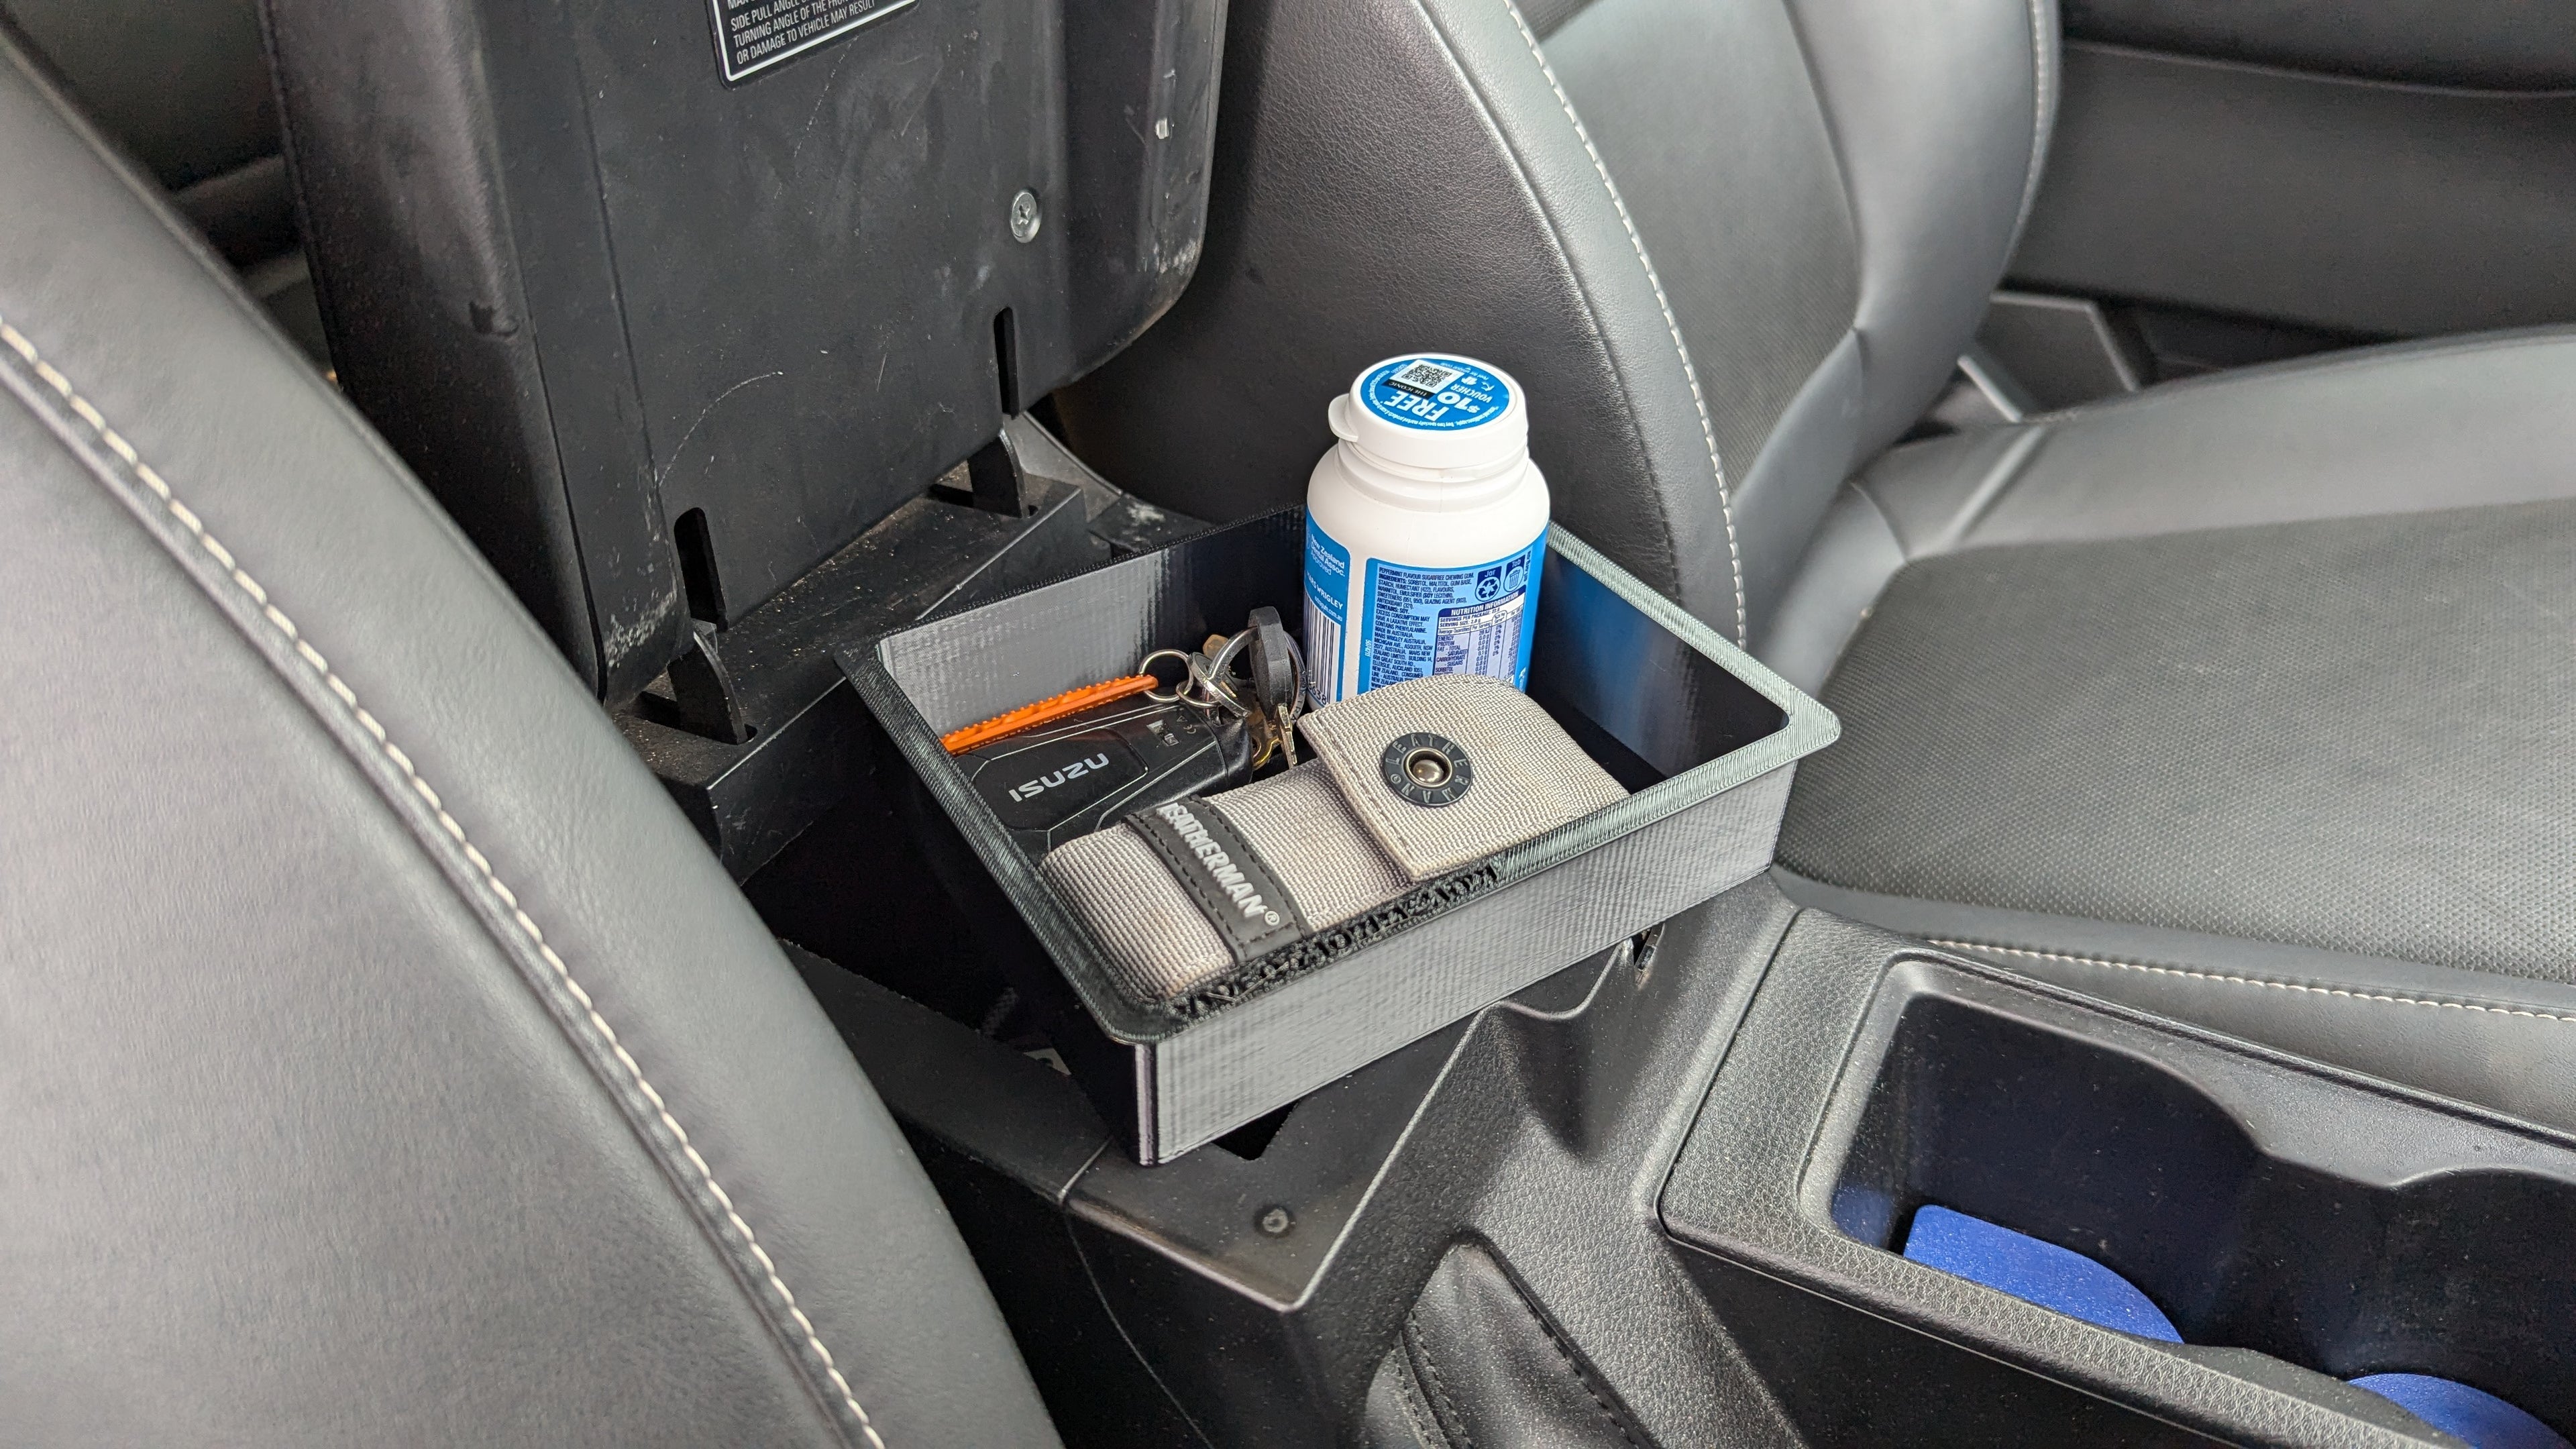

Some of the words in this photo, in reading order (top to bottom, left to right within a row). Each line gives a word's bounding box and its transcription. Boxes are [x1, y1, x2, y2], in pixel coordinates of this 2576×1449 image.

[731, 12, 751, 32] SIDE
[751, 5, 772, 23] PULL
[733, 22, 772, 48] TURNING
[773, 10, 799, 32] ANGLE
[800, 5, 810, 20] OF
[812, 0, 827, 15] THE
[737, 49, 749, 65] OR
[750, 33, 786, 59] DAMAGE
[786, 28, 797, 43] TO
[798, 15, 829, 38] VEHICLE
[830, 7, 847, 25] MAY
[1389, 381, 1414, 392] ICONIC
[1450, 384, 1493, 403] VOUCHER
[1383, 390, 1450, 422] FREE
[1437, 392, 1481, 413] $10
[1311, 549, 1332, 576] Approved
[1321, 546, 1345, 569] Zealand
[1324, 557, 1345, 577] Assoc.
[1379, 567, 1403, 577] PEPPERMINT
[1379, 574, 1407, 584] INGREDIENTS:
[1317, 584, 1343, 610] WRIGLEY
[1377, 592, 1402, 601] SWEETENERS
[1395, 583, 1419, 592] HUMECTANT
[1451, 606, 1484, 616] NUTRITION
[1485, 592, 1519, 610] INFORMATION
[1376, 608, 1391, 616] EXCESS
[1391, 612, 1420, 622] CONSUMPTION
[1390, 618, 1408, 626] LAXATIVE
[1375, 621, 1394, 629] CONTAINS
[1387, 634, 1403, 643] WRIGLEY
[1373, 649, 1390, 657] ZEALAND
[1008, 753, 1109, 802] ISUZU
